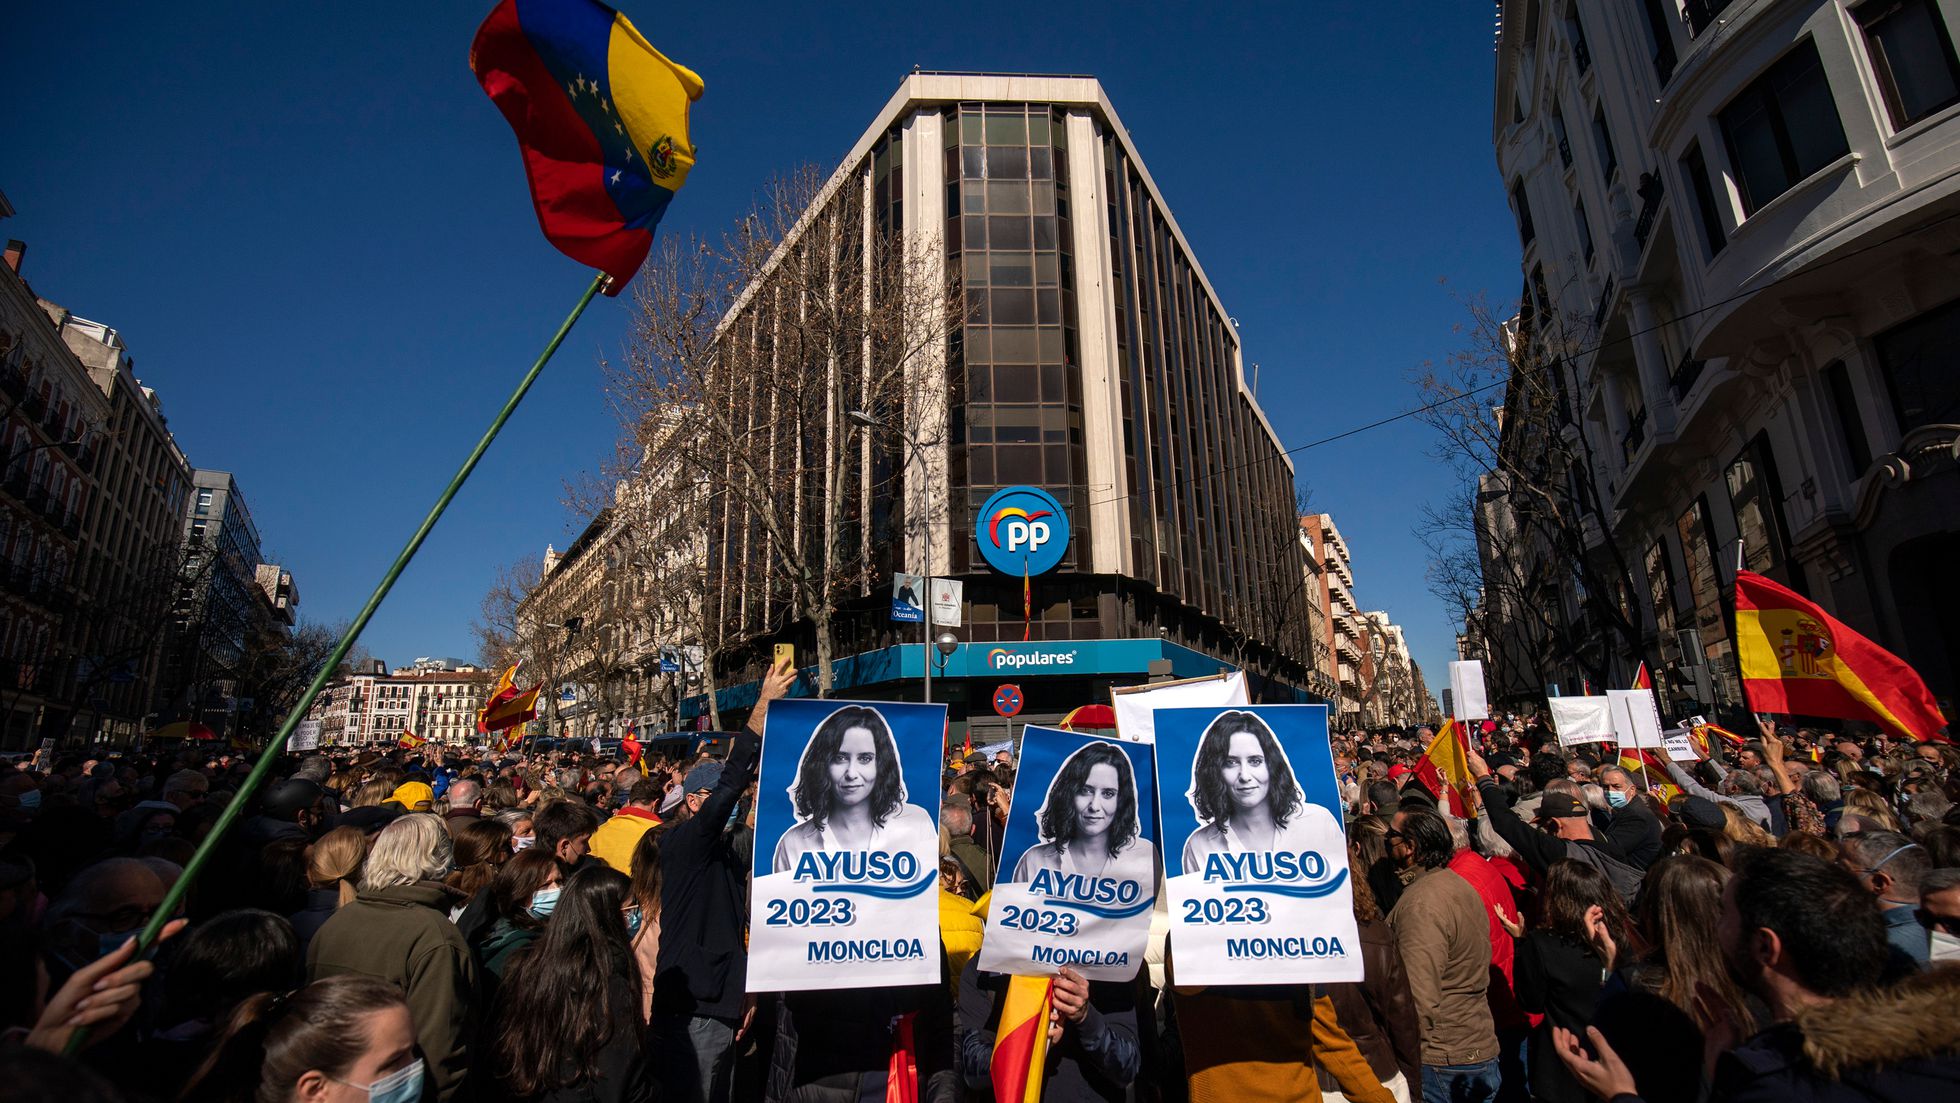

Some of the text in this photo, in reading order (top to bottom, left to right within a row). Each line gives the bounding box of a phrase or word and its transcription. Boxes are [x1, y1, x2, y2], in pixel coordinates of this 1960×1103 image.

[793, 851, 918, 881] AYUSO
[1203, 851, 1326, 881] AYUSO
[1028, 868, 1140, 904] AYUSO
[766, 898, 854, 926] 2023
[1000, 905, 1077, 935] 2023
[1182, 897, 1267, 924] 2023
[807, 938, 924, 961] MONCLOA
[1031, 945, 1128, 965] MONCLOA
[1227, 937, 1345, 958] MONCLOA
